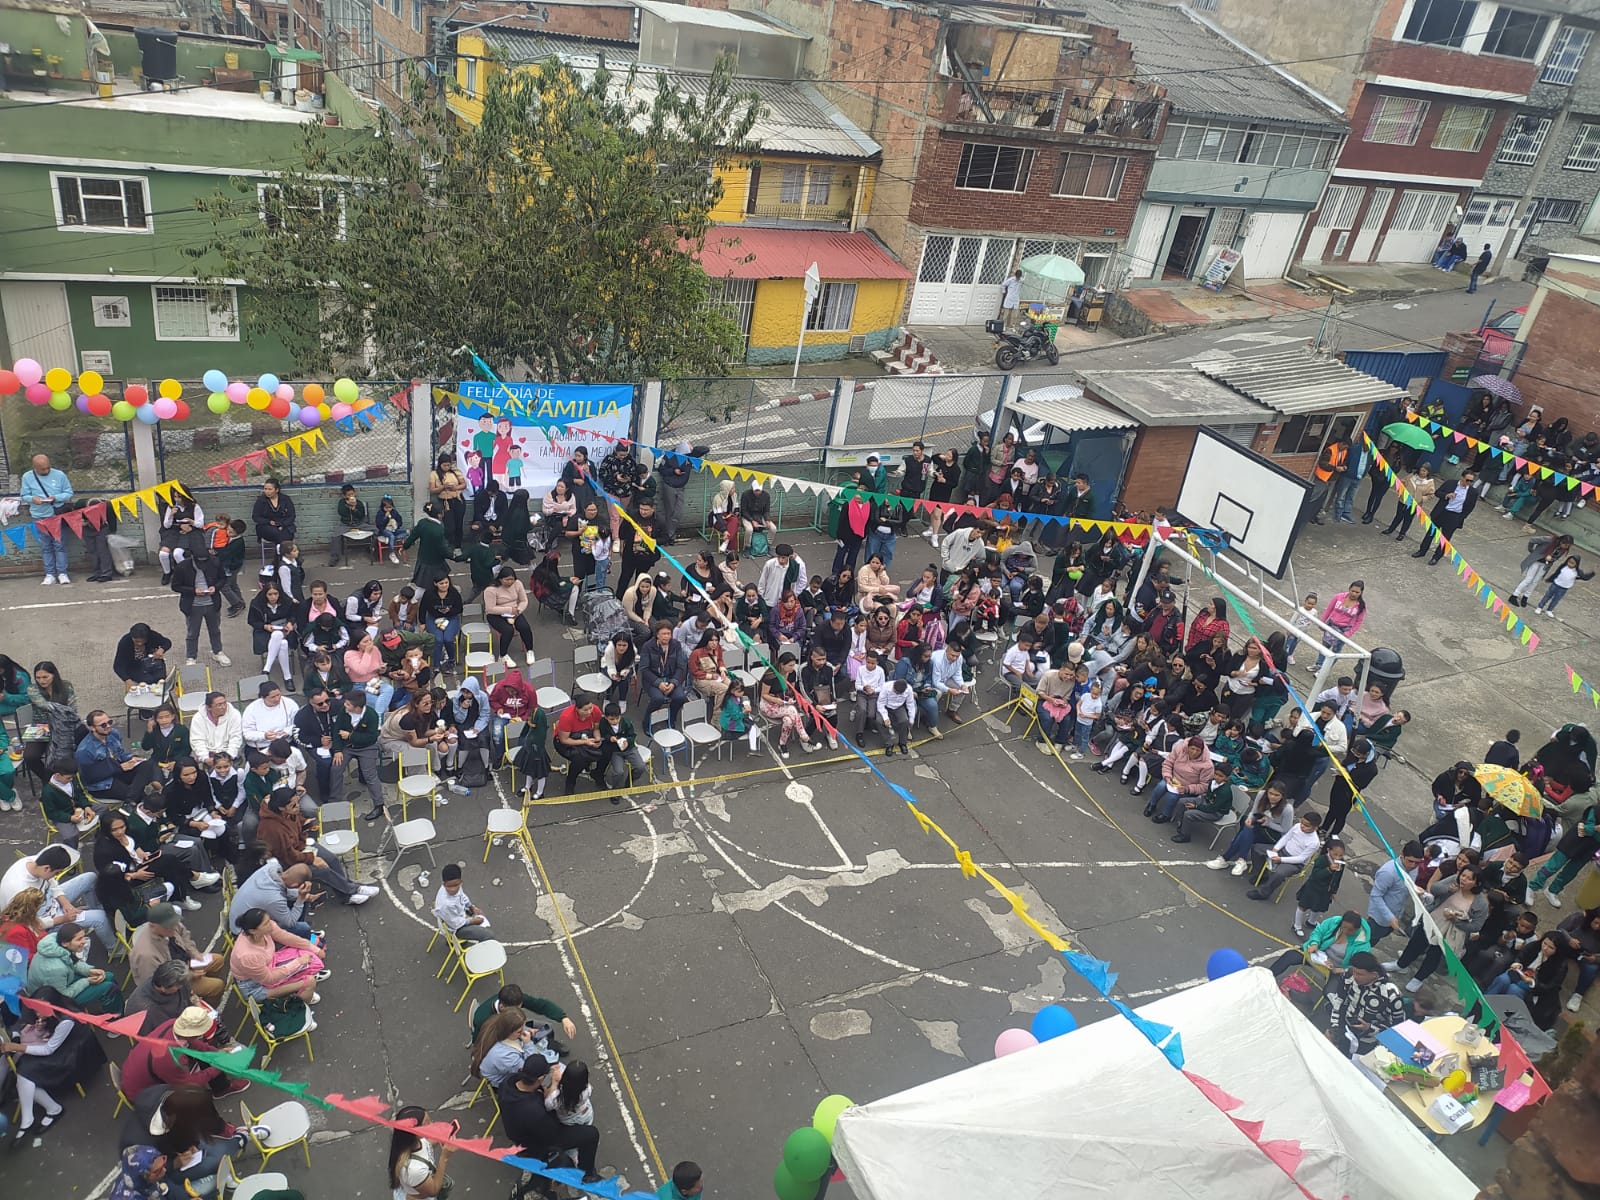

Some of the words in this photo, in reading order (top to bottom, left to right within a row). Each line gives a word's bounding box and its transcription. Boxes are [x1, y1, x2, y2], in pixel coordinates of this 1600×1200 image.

[467, 386, 504, 399] FELIZ
[508, 385, 532, 399] DÍA
[537, 387, 556, 400] DE
[527, 399, 620, 418] FAMILIA
[539, 446, 571, 458] FAMILIA
[590, 446, 614, 458] MEJO
